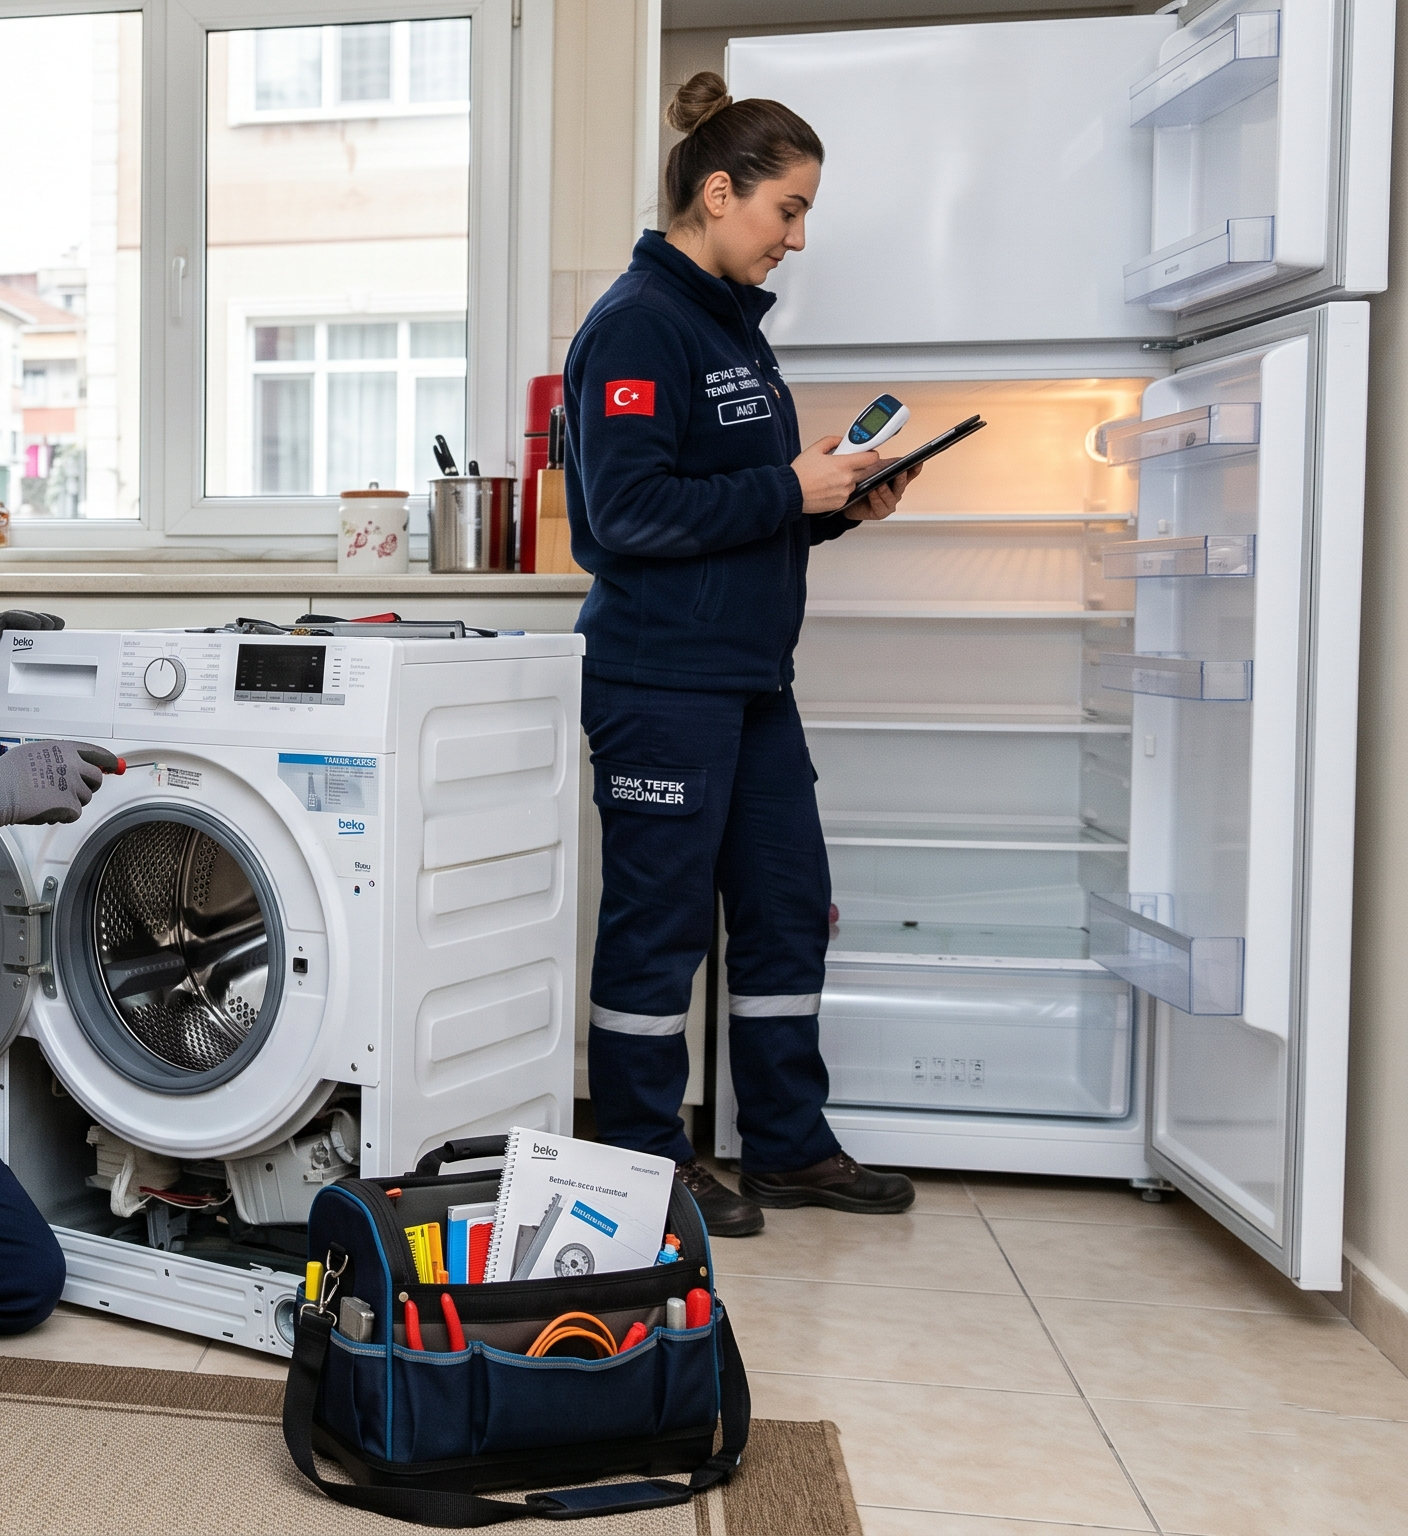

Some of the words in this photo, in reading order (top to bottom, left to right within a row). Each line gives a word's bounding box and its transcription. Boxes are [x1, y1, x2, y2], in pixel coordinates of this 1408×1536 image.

[12, 636, 34, 647] beko
[644, 779, 685, 793] TEFEK
[338, 818, 365, 831] beko
[533, 1143, 559, 1157] beko
